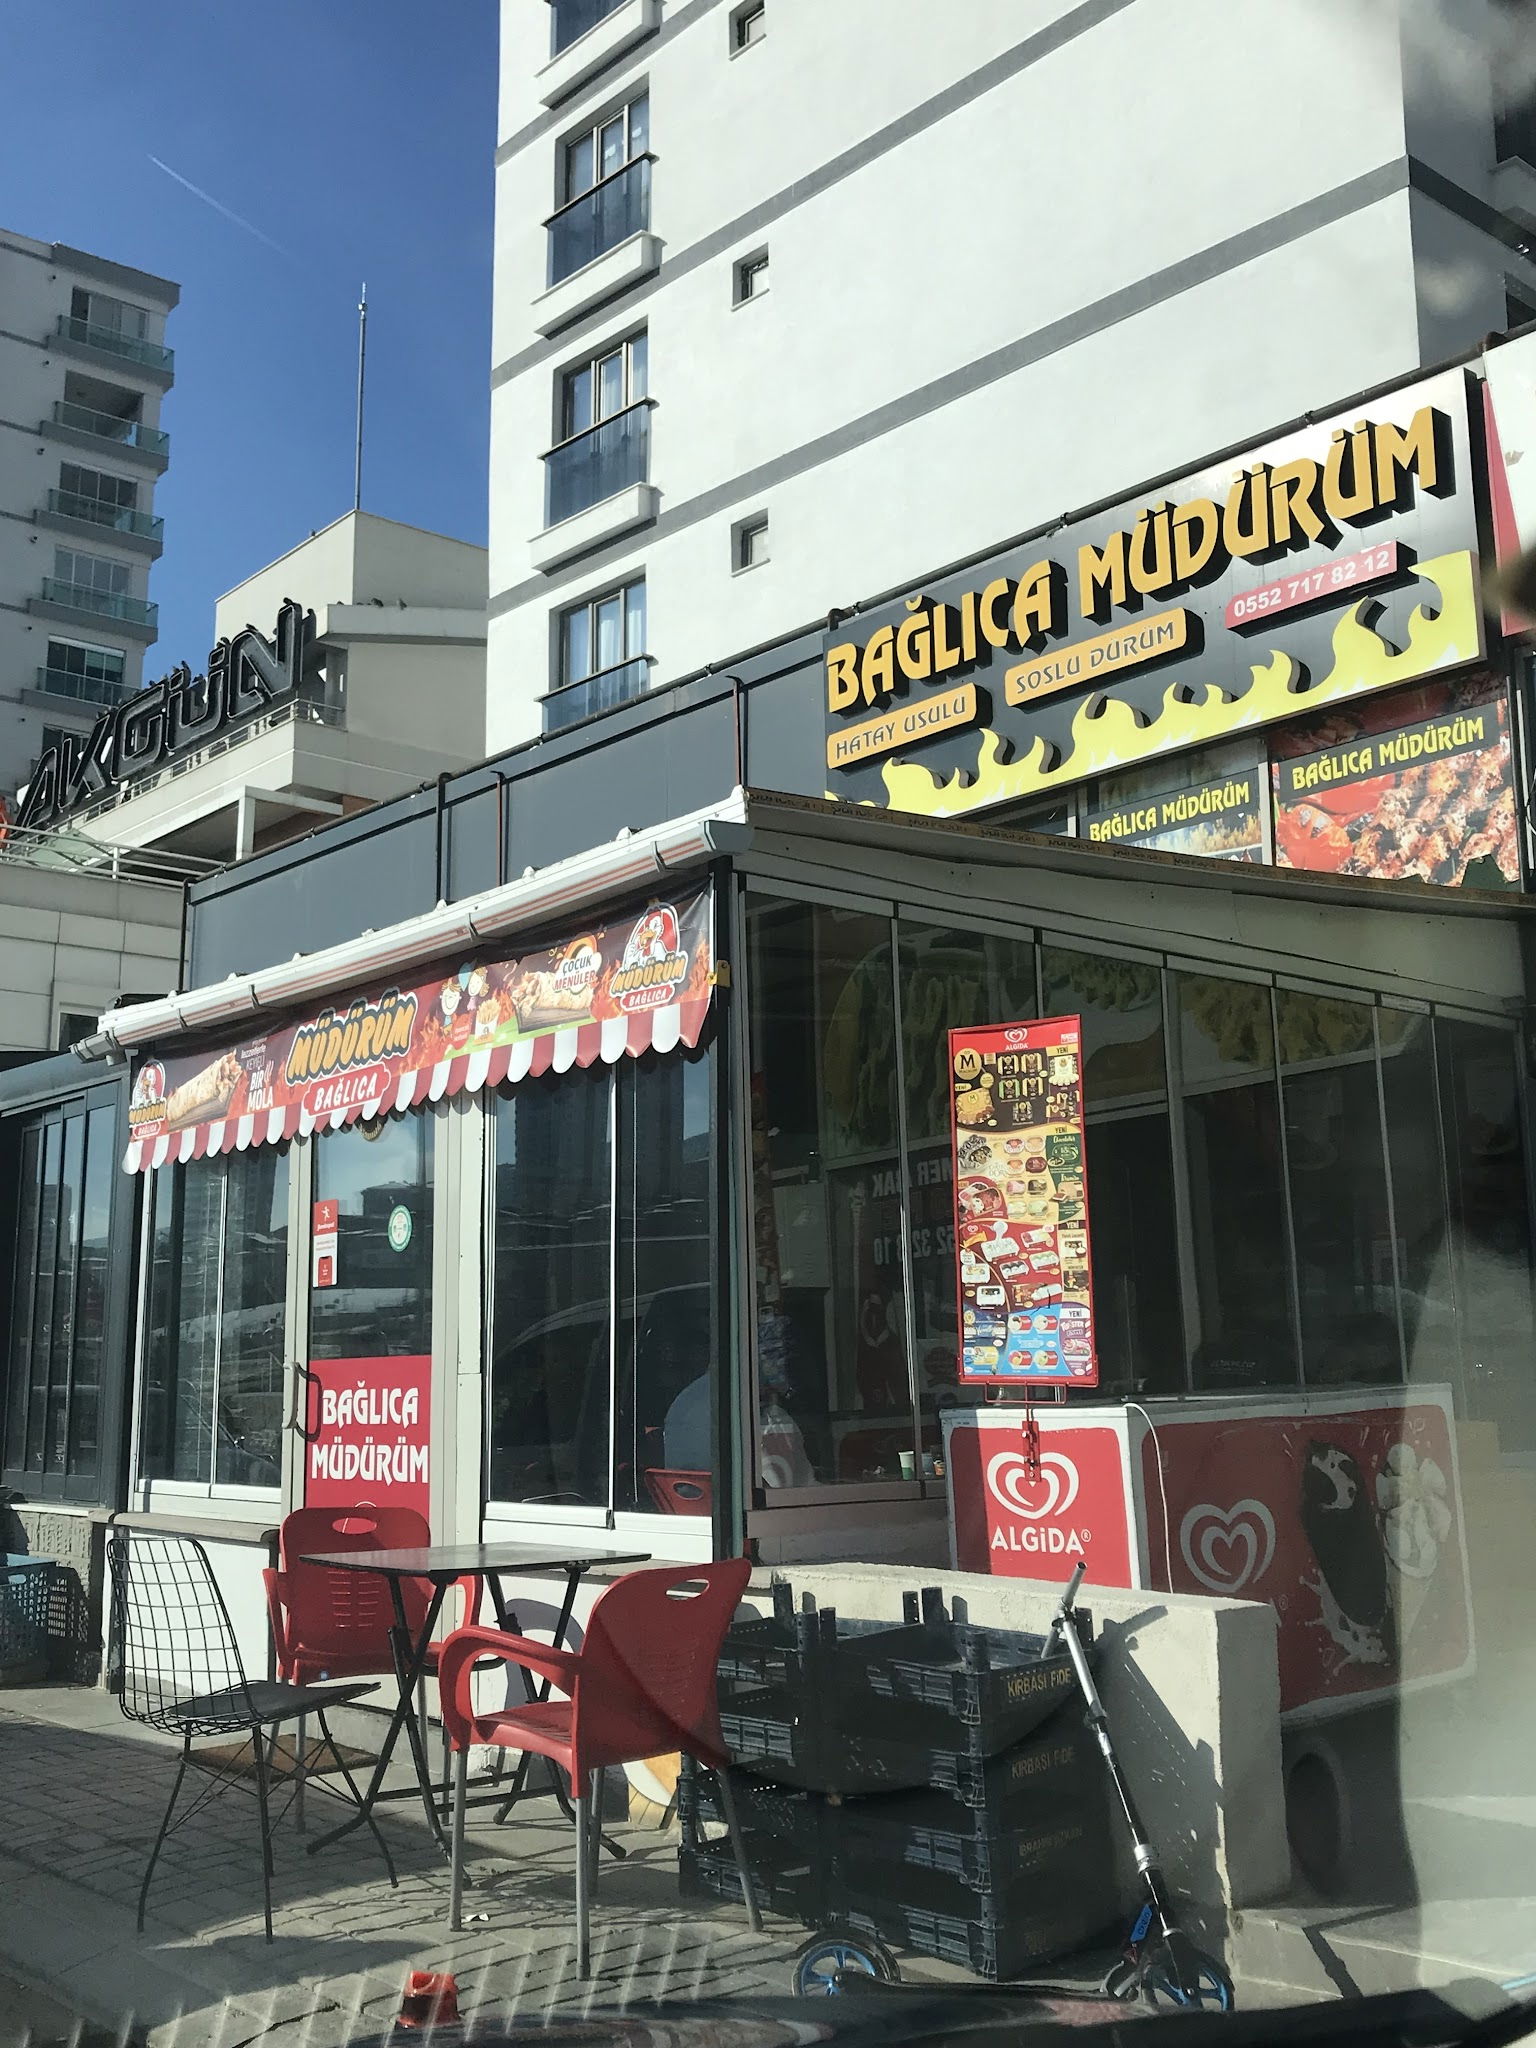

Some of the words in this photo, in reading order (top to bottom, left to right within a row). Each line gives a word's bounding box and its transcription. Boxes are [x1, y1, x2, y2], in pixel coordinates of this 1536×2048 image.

[826, 559, 1052, 713] BAĞLICA
[1077, 405, 1437, 618] MÜDÜRÜM
[1233, 587, 1282, 618] 0552
[1288, 572, 1325, 600] 717
[1331, 560, 1357, 585] 82
[1364, 550, 1390, 573] 12
[1016, 656, 1080, 694] SOSLU
[835, 722, 896, 759] HATAY
[1292, 748, 1373, 790] BAĞLICA
[1379, 716, 1484, 766] MÜDÜRÜM
[1090, 806, 1157, 842] BAĞLICA
[1162, 780, 1250, 826] MÜDÜRÜM
[553, 968, 597, 992] MENÜLER
[562, 955, 593, 975] ÇOCUK
[612, 954, 687, 993] MÜDÜRÜM
[287, 996, 416, 1080] MÜDÜRÜM
[246, 1086, 274, 1114] MOLA
[313, 1071, 378, 1112] BAĞLICA
[322, 1380, 419, 1431] BAĞLICA
[311, 1436, 429, 1487] MÜDÜRÜM
